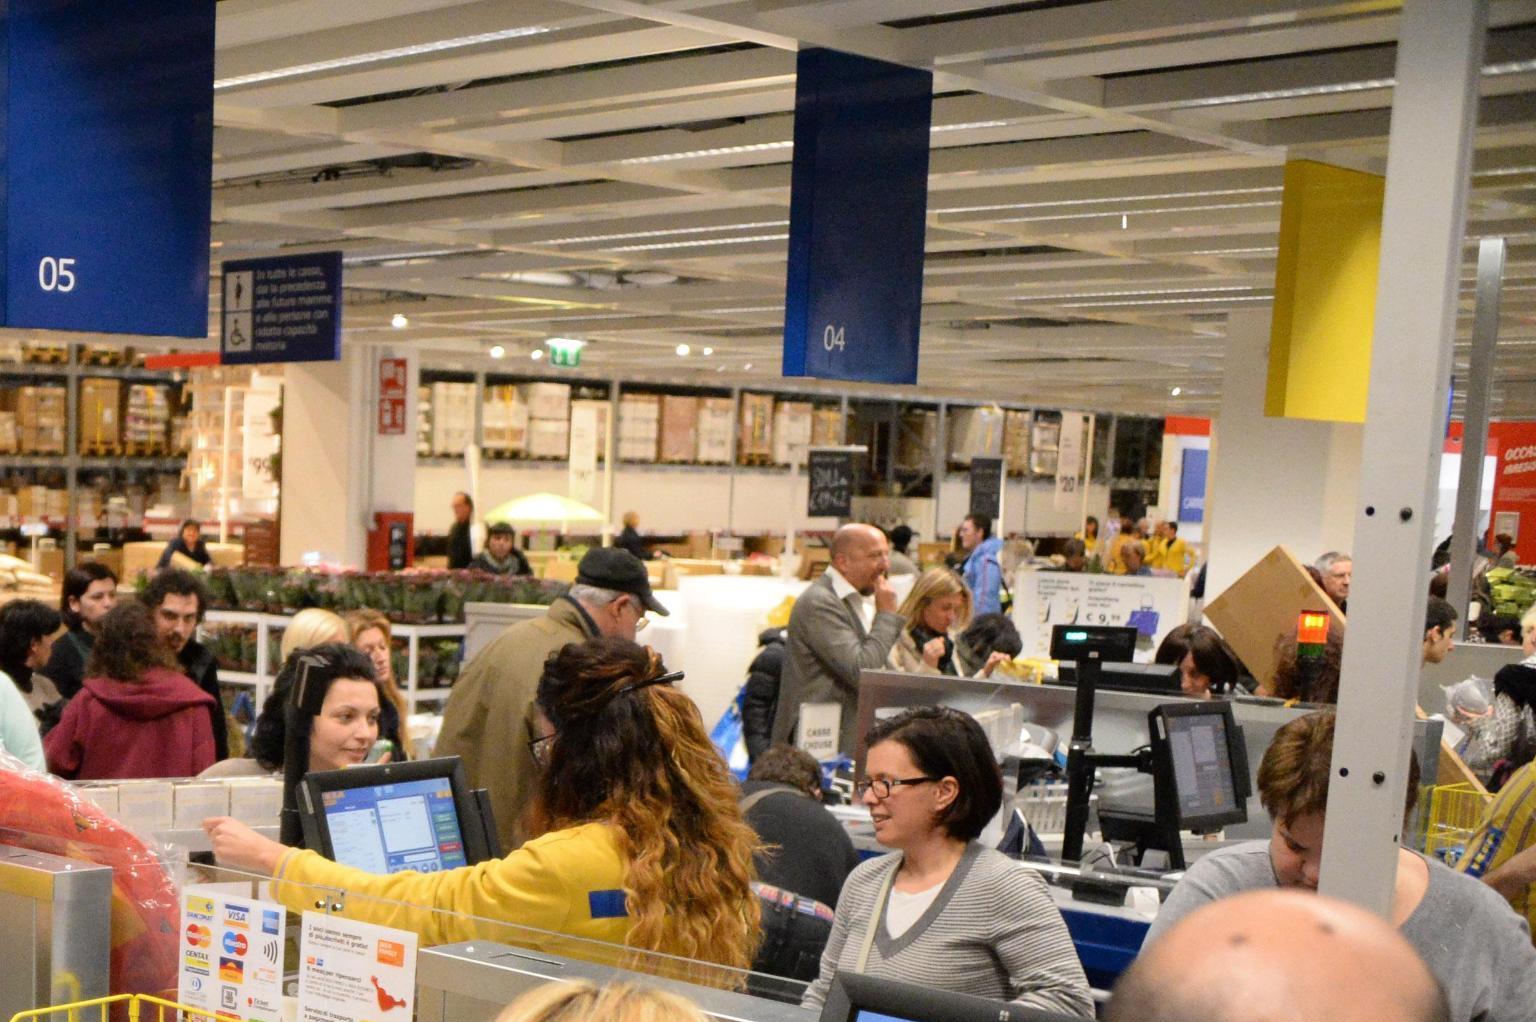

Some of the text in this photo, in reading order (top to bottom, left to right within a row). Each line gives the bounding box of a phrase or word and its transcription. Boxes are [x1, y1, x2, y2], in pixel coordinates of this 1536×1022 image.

[39, 256, 75, 292] 05
[824, 324, 846, 352] 04
[228, 910, 246, 921] VISA
